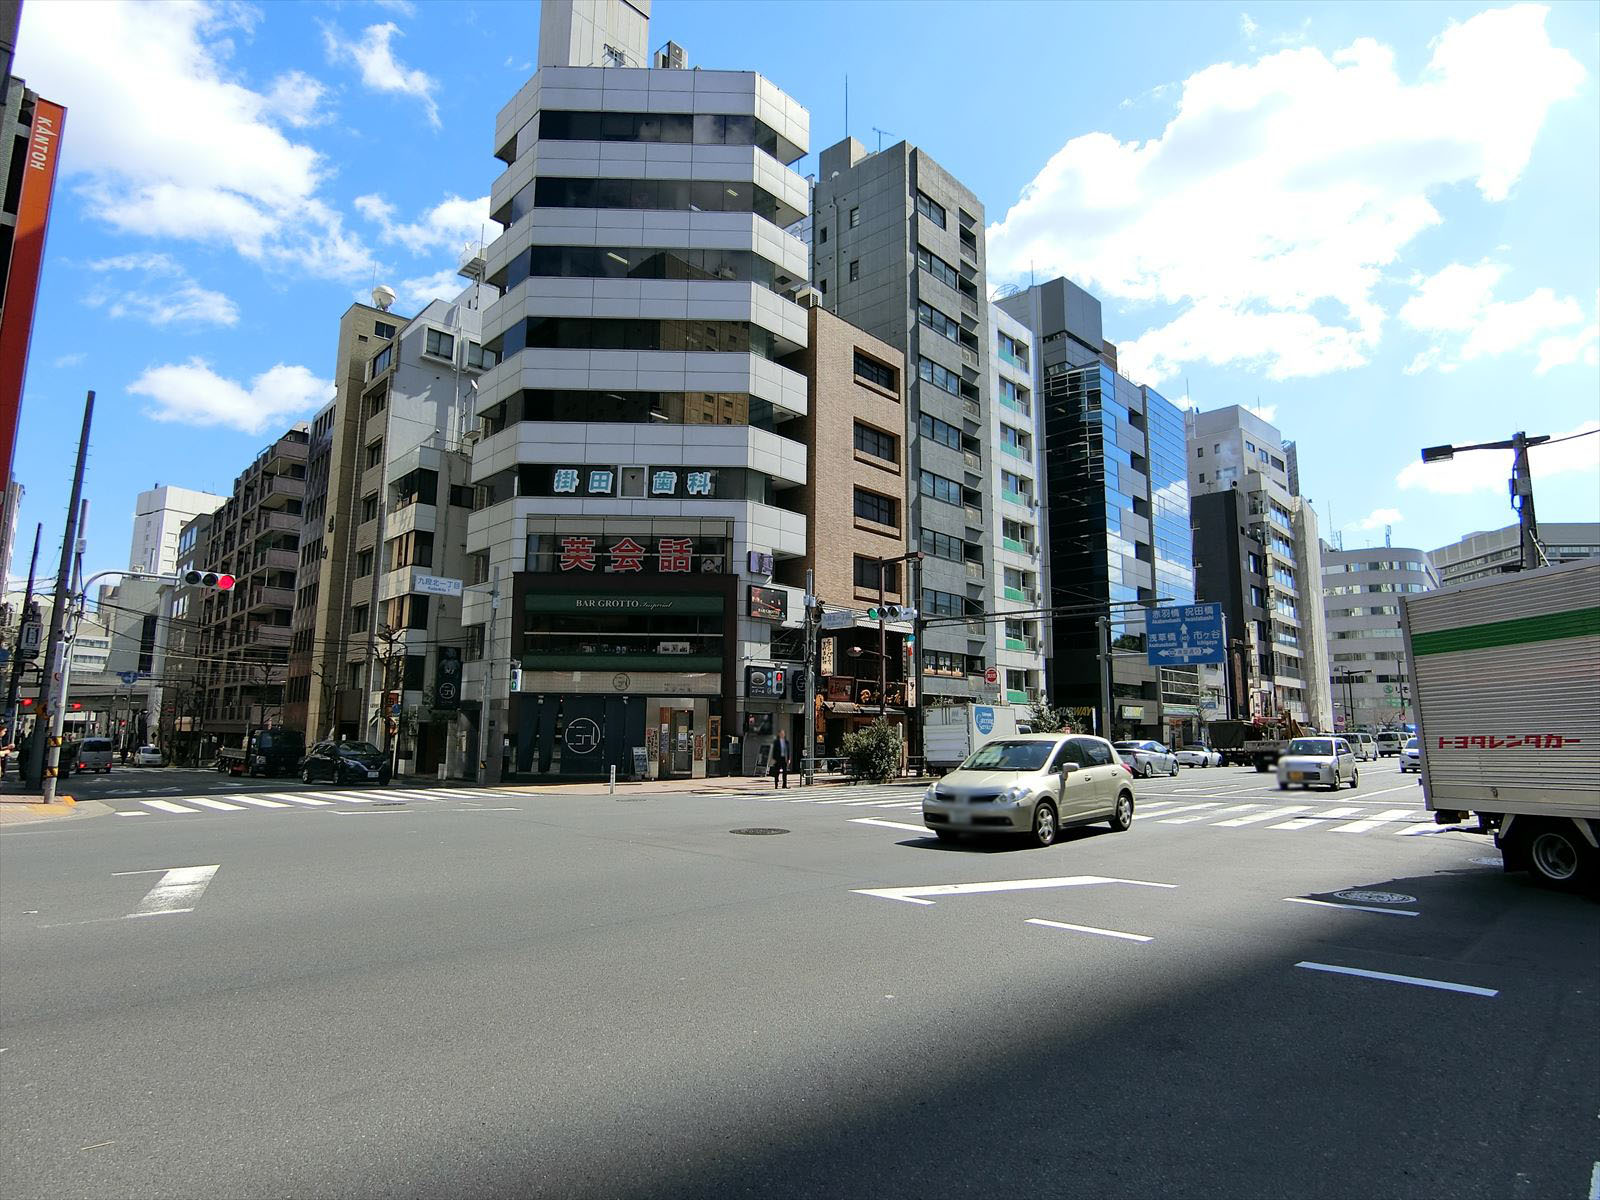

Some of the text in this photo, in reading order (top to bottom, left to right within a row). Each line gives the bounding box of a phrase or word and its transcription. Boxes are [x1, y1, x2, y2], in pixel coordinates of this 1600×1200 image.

[30, 116, 57, 171] KANTOH
[559, 537, 693, 573] 英会話
[418, 577, 460, 589] 九段北一丁目
[576, 599, 596, 607] BAR
[598, 599, 639, 607] GROTTO
[1439, 734, 1581, 749] トヨタレンタカー
